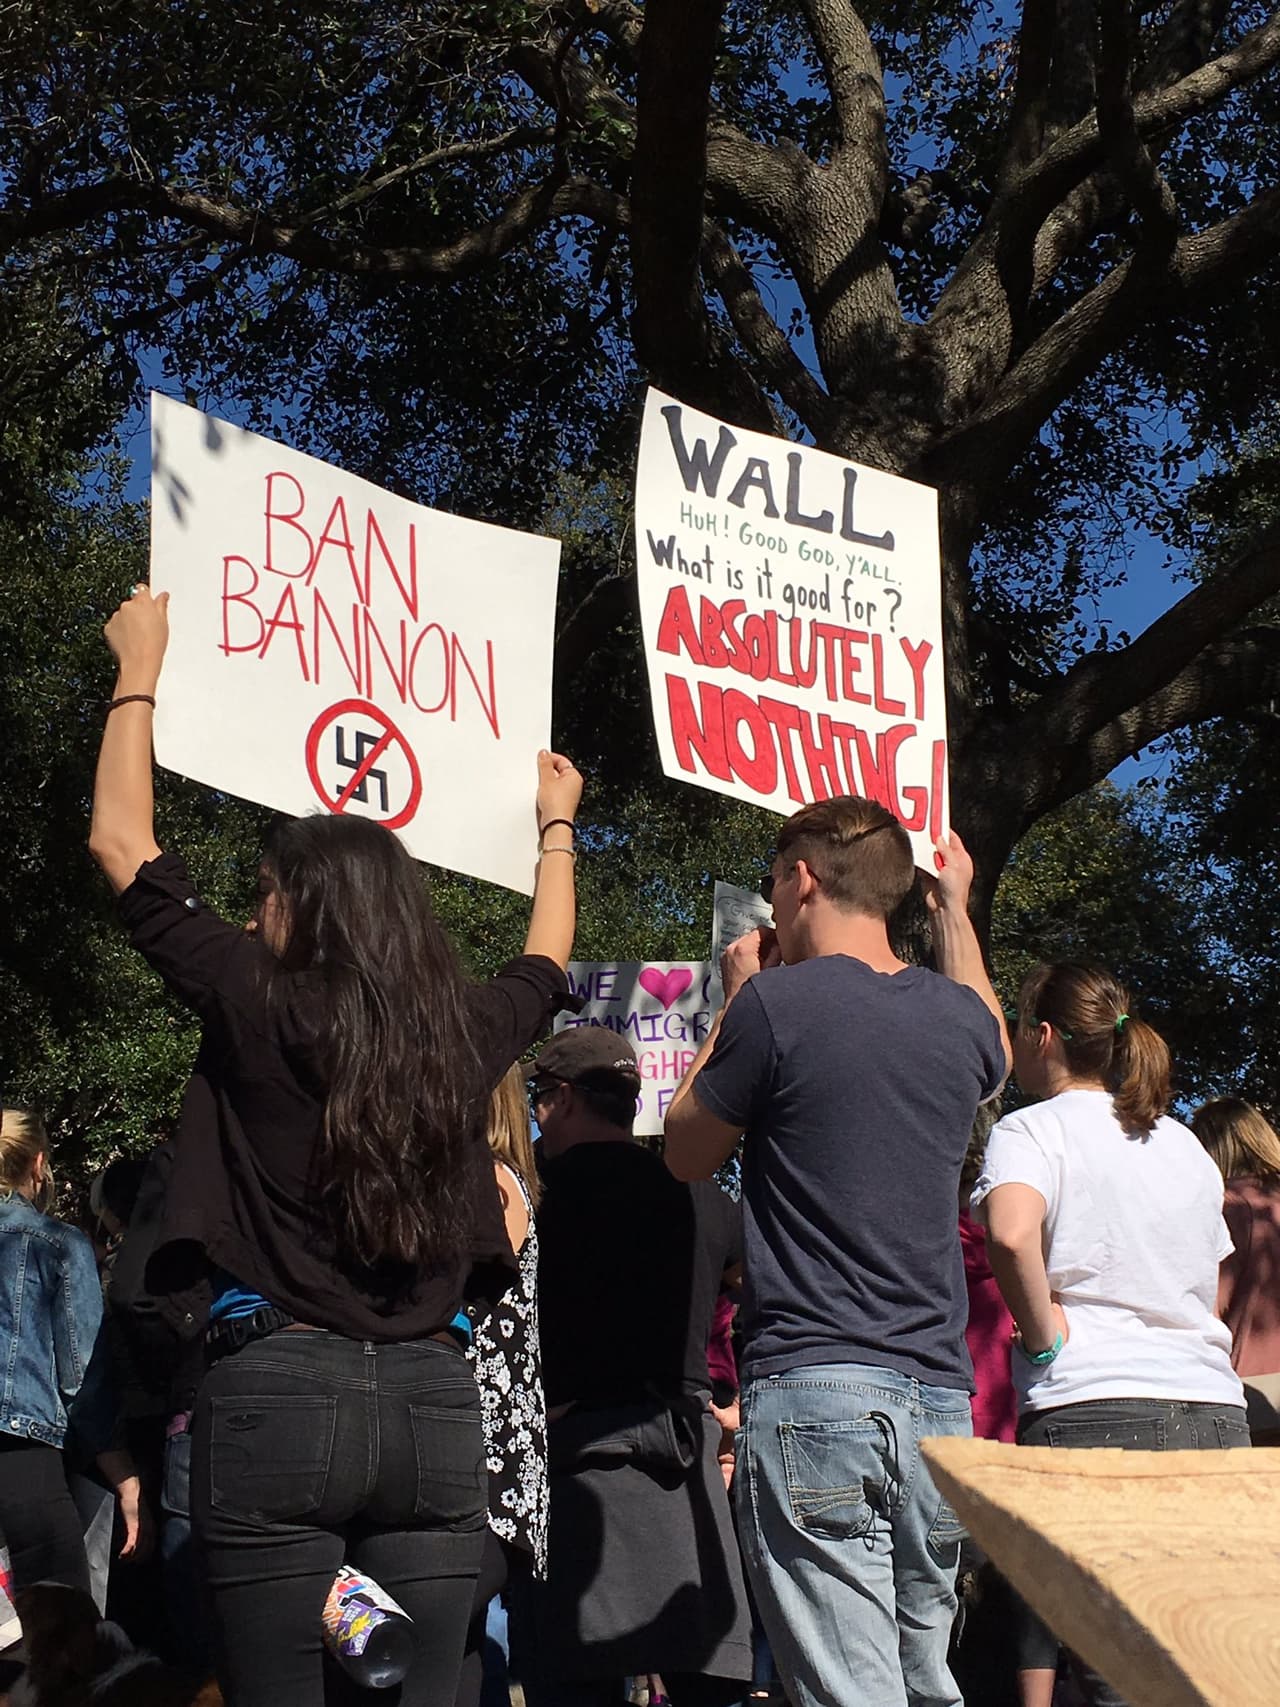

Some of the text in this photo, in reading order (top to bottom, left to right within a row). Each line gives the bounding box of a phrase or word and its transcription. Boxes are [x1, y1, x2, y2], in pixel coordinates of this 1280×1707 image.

[264, 472, 418, 622] BAN
[661, 405, 895, 551] WALL
[680, 501, 730, 537] HUH!
[739, 522, 788, 554] GOOD
[646, 529, 714, 584] What
[727, 560, 744, 590] is
[756, 558, 773, 599] it
[778, 574, 831, 623] good
[217, 555, 500, 740] BANNON
[656, 585, 933, 721] ABSOLUTELY
[665, 672, 946, 872] NOTHING!
[567, 970, 622, 1001] WE
